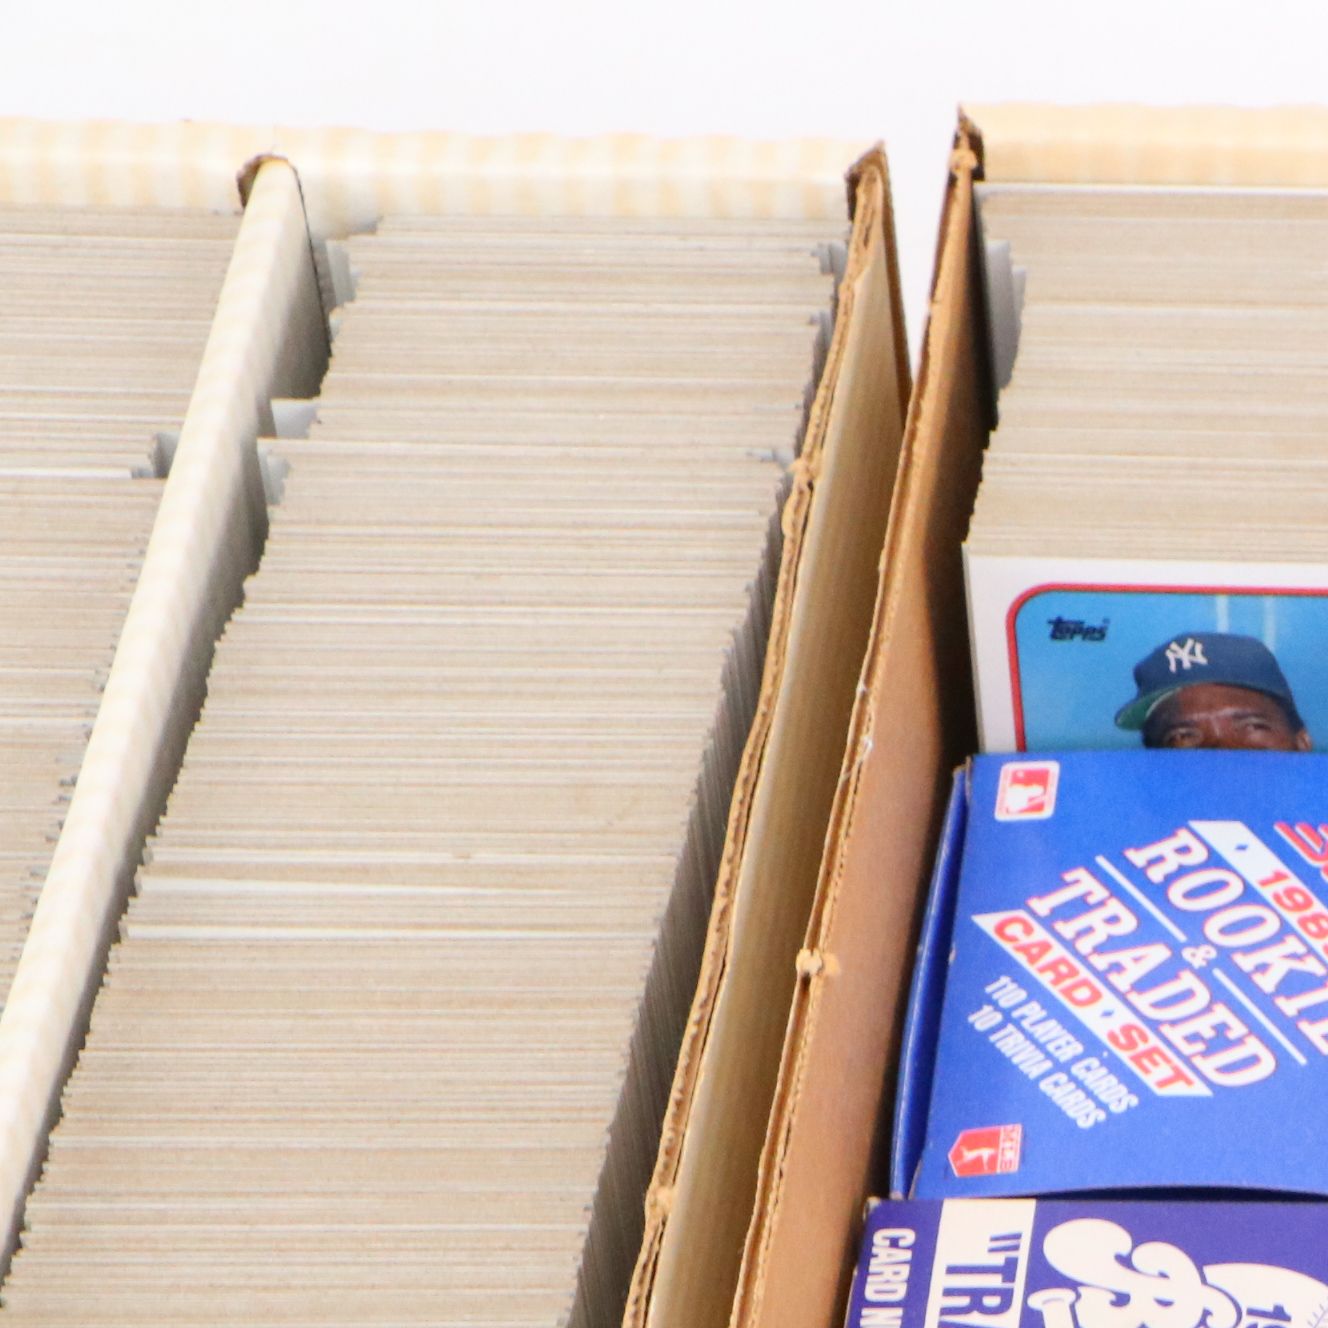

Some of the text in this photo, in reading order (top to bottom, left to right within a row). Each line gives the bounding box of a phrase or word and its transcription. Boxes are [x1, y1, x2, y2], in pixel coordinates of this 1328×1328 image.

[993, 916, 1195, 1089] CARD SET
[1026, 866, 1277, 1087] TRADED
[1180, 943, 1218, 970] &
[967, 1004, 1106, 1129] 10 TRIVIA CARDS
[984, 975, 1139, 1113] 110 PLAYER CARDS
[864, 1227, 916, 1303] CARD
